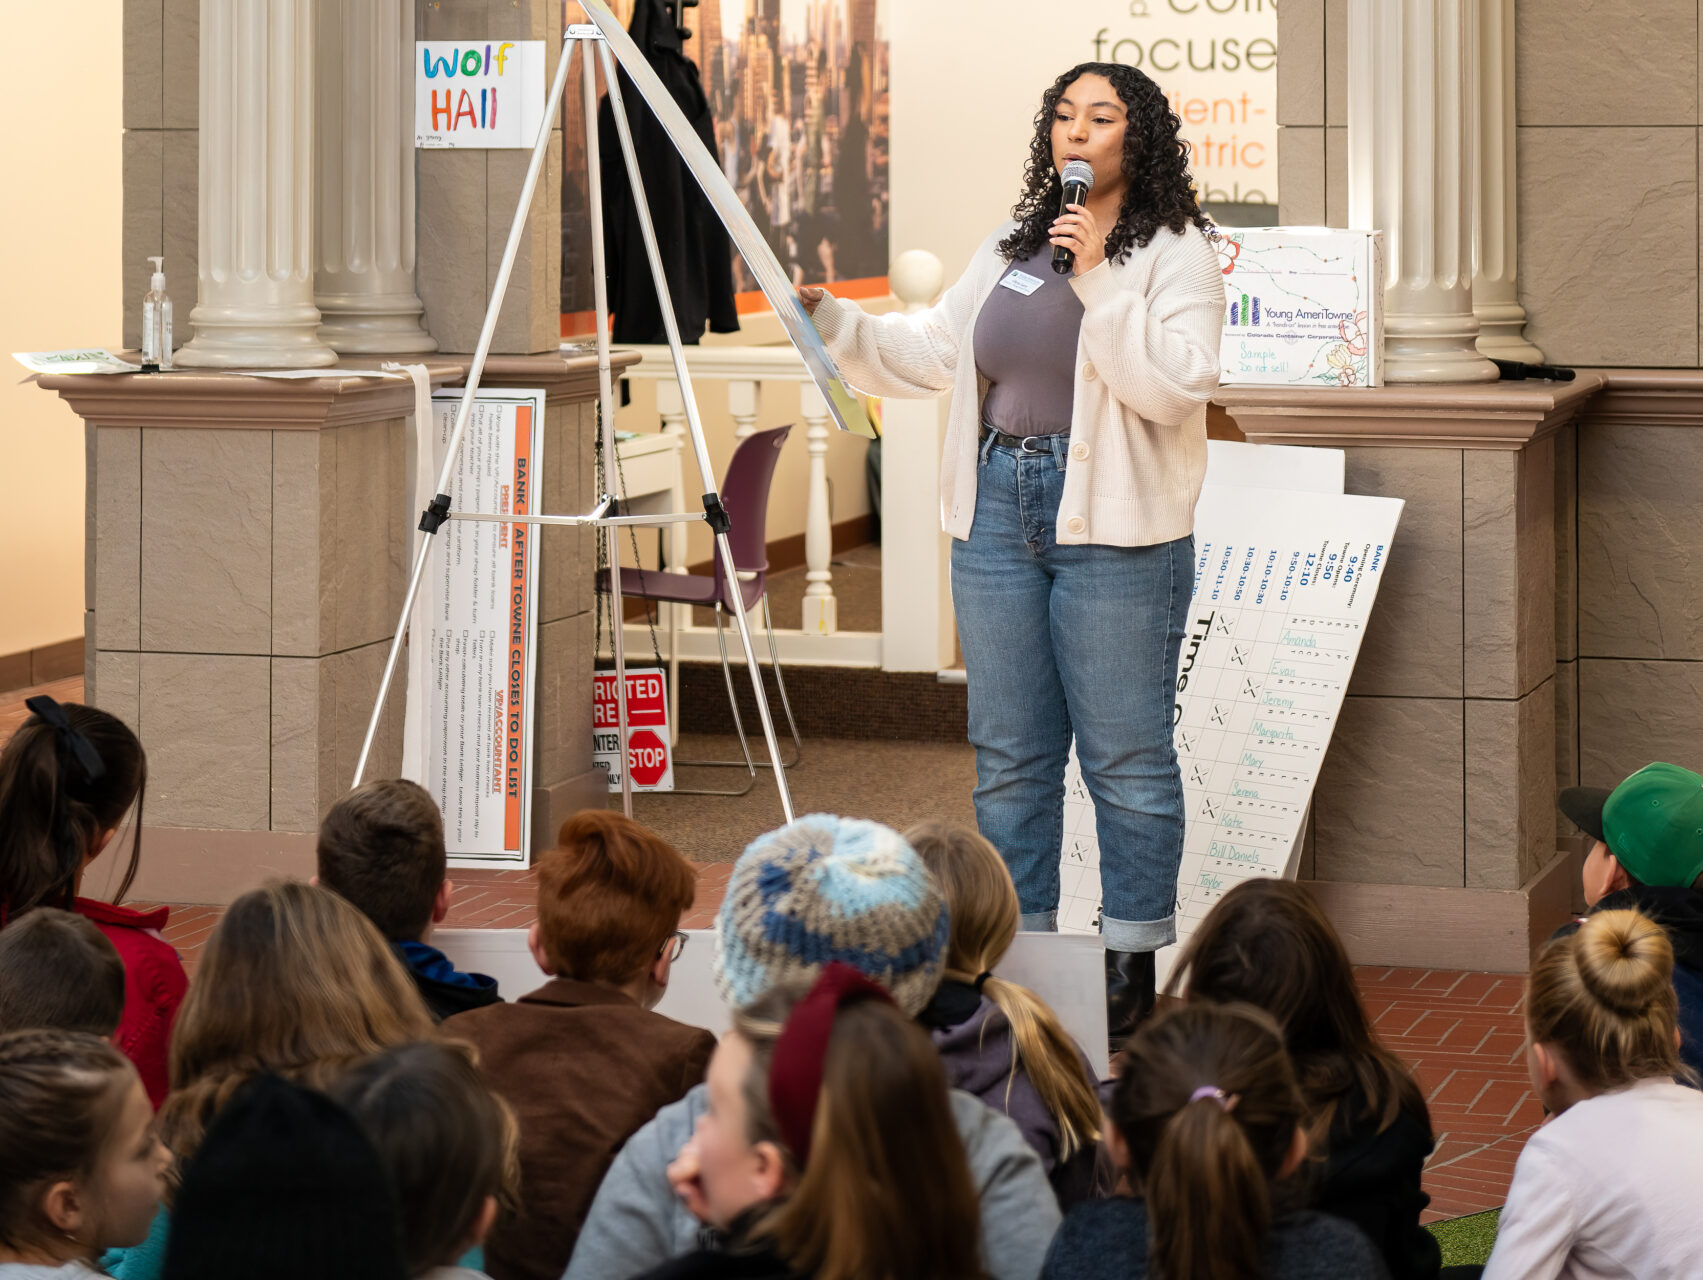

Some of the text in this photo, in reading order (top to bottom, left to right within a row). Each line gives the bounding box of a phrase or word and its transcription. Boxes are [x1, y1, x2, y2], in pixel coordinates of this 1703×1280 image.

[1092, 28, 1277, 71] focuse
[1265, 307, 1353, 321] Young AmeriTowne
[1240, 341, 1277, 361] Sample
[1299, 552, 1316, 586] 12:10
[1310, 540, 1330, 586] Towne Closes:
[1322, 553, 1338, 580] 9:50
[1332, 542, 1351, 588] Towne Opens:
[1343, 555, 1358, 583] 9:40
[1370, 544, 1384, 572] BANK
[1234, 547, 1255, 601] 10:30-10:50
[1256, 549, 1277, 605] 10:10-10:30
[1280, 551, 1300, 601] 9:50-10:10
[1347, 543, 1371, 609] Opening Ceremony:
[508, 457, 527, 799] BANK AFTER TOWNE CLOSES TO DO LIST
[1281, 630, 1318, 649] Amanda
[1176, 611, 1216, 694] Time
[1271, 661, 1297, 678] Evan
[1263, 691, 1294, 710] Jeremy
[493, 689, 504, 795] VP/ACCOUNTANT
[1252, 722, 1295, 743] Margarita
[629, 748, 665, 768] STOP
[1241, 752, 1265, 769] Mary
[1232, 782, 1260, 798] Serena
[1221, 812, 1244, 828] Katie
[1208, 841, 1260, 864] Bill Daniels
[1199, 873, 1224, 892] Taylor
